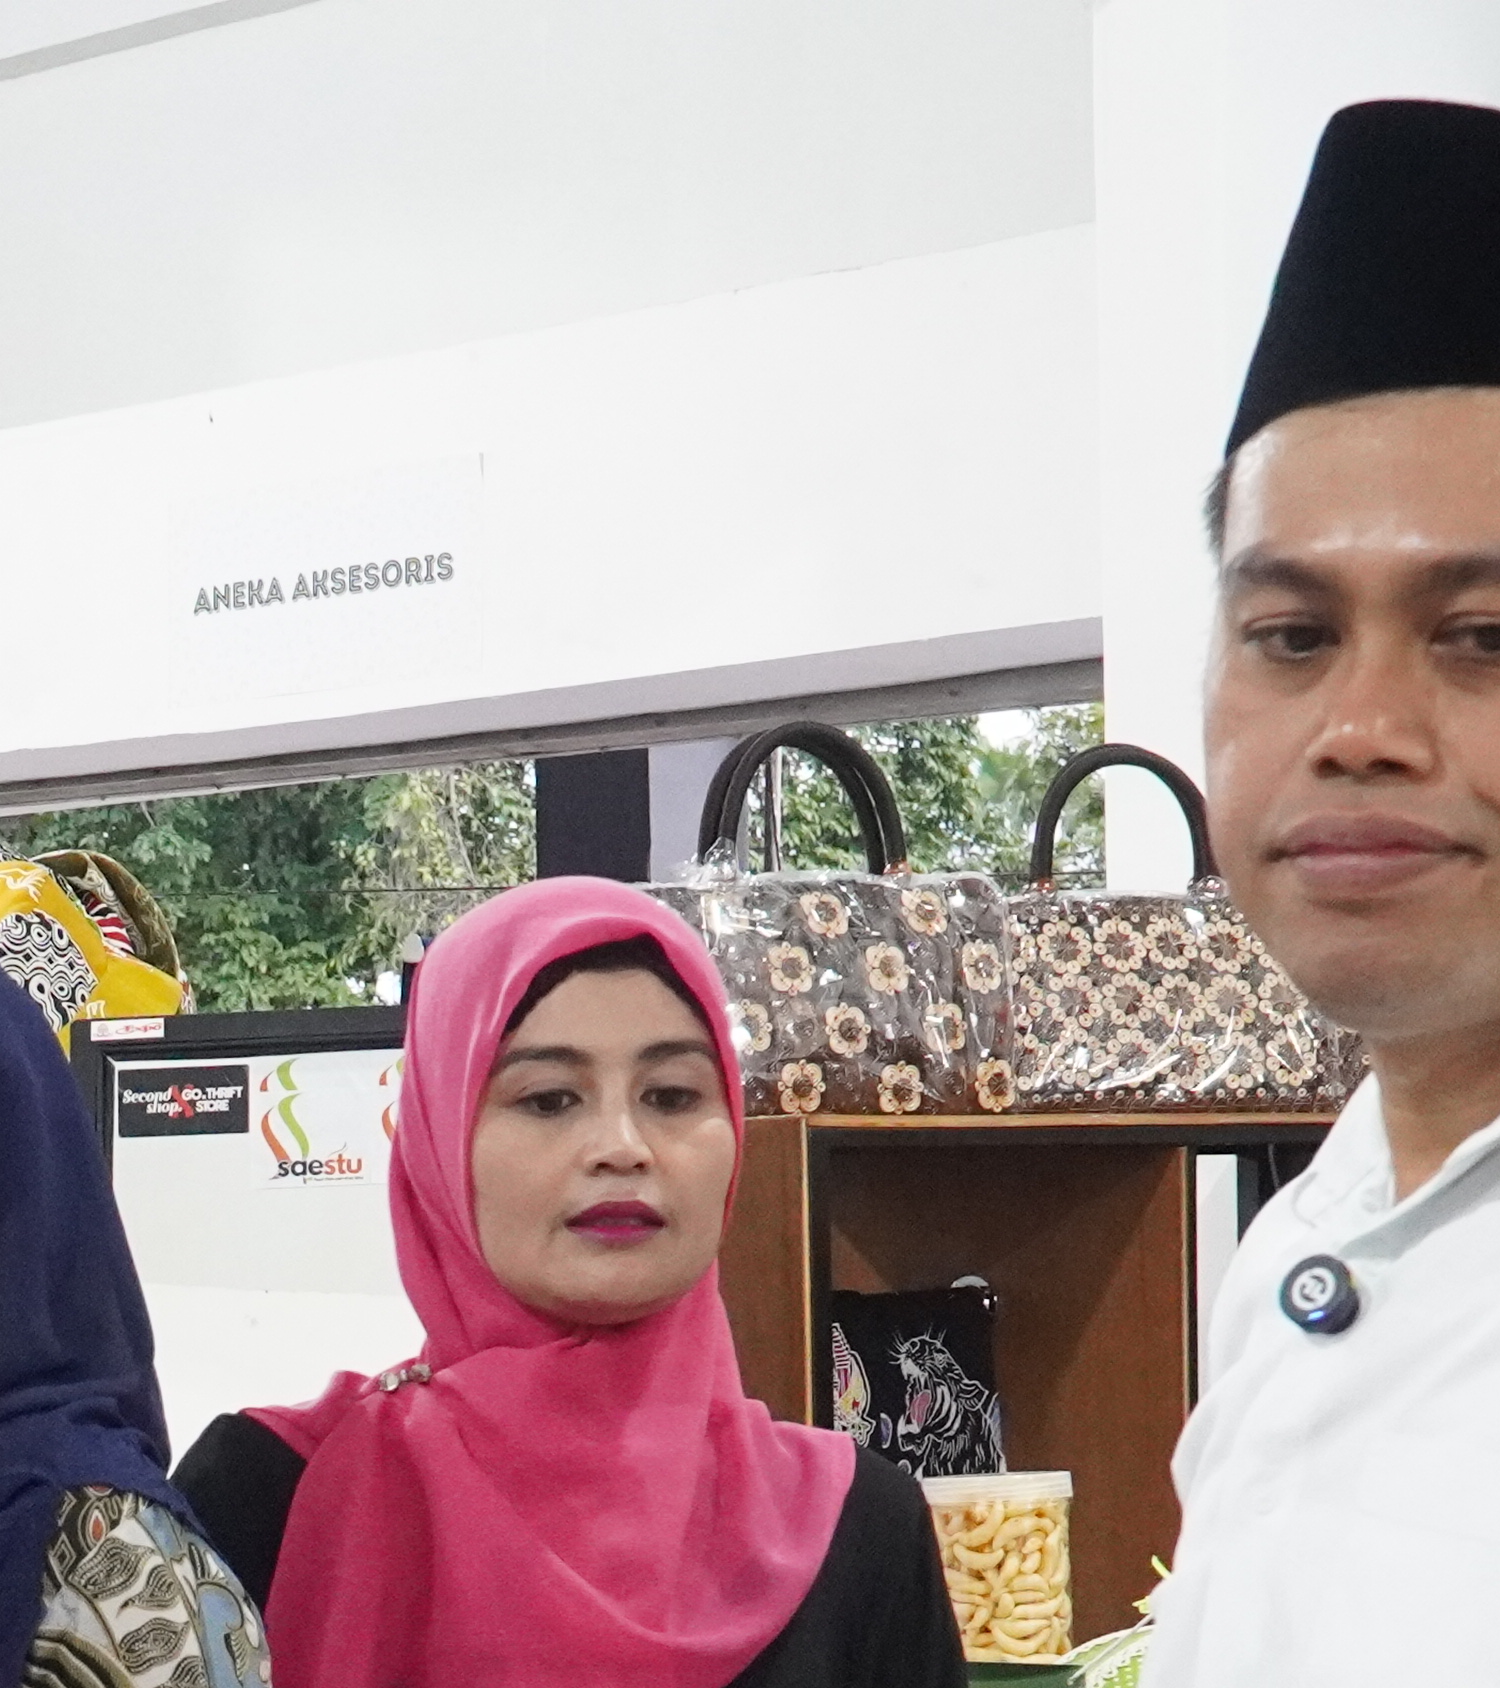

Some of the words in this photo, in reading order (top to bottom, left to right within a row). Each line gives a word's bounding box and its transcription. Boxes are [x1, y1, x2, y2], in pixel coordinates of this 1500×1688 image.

[193, 576, 286, 617] ANEKA
[291, 552, 454, 601] AKSESORIS
[122, 1086, 174, 1104] Second
[195, 1099, 230, 1113] STORE
[278, 1153, 363, 1177] saestu
